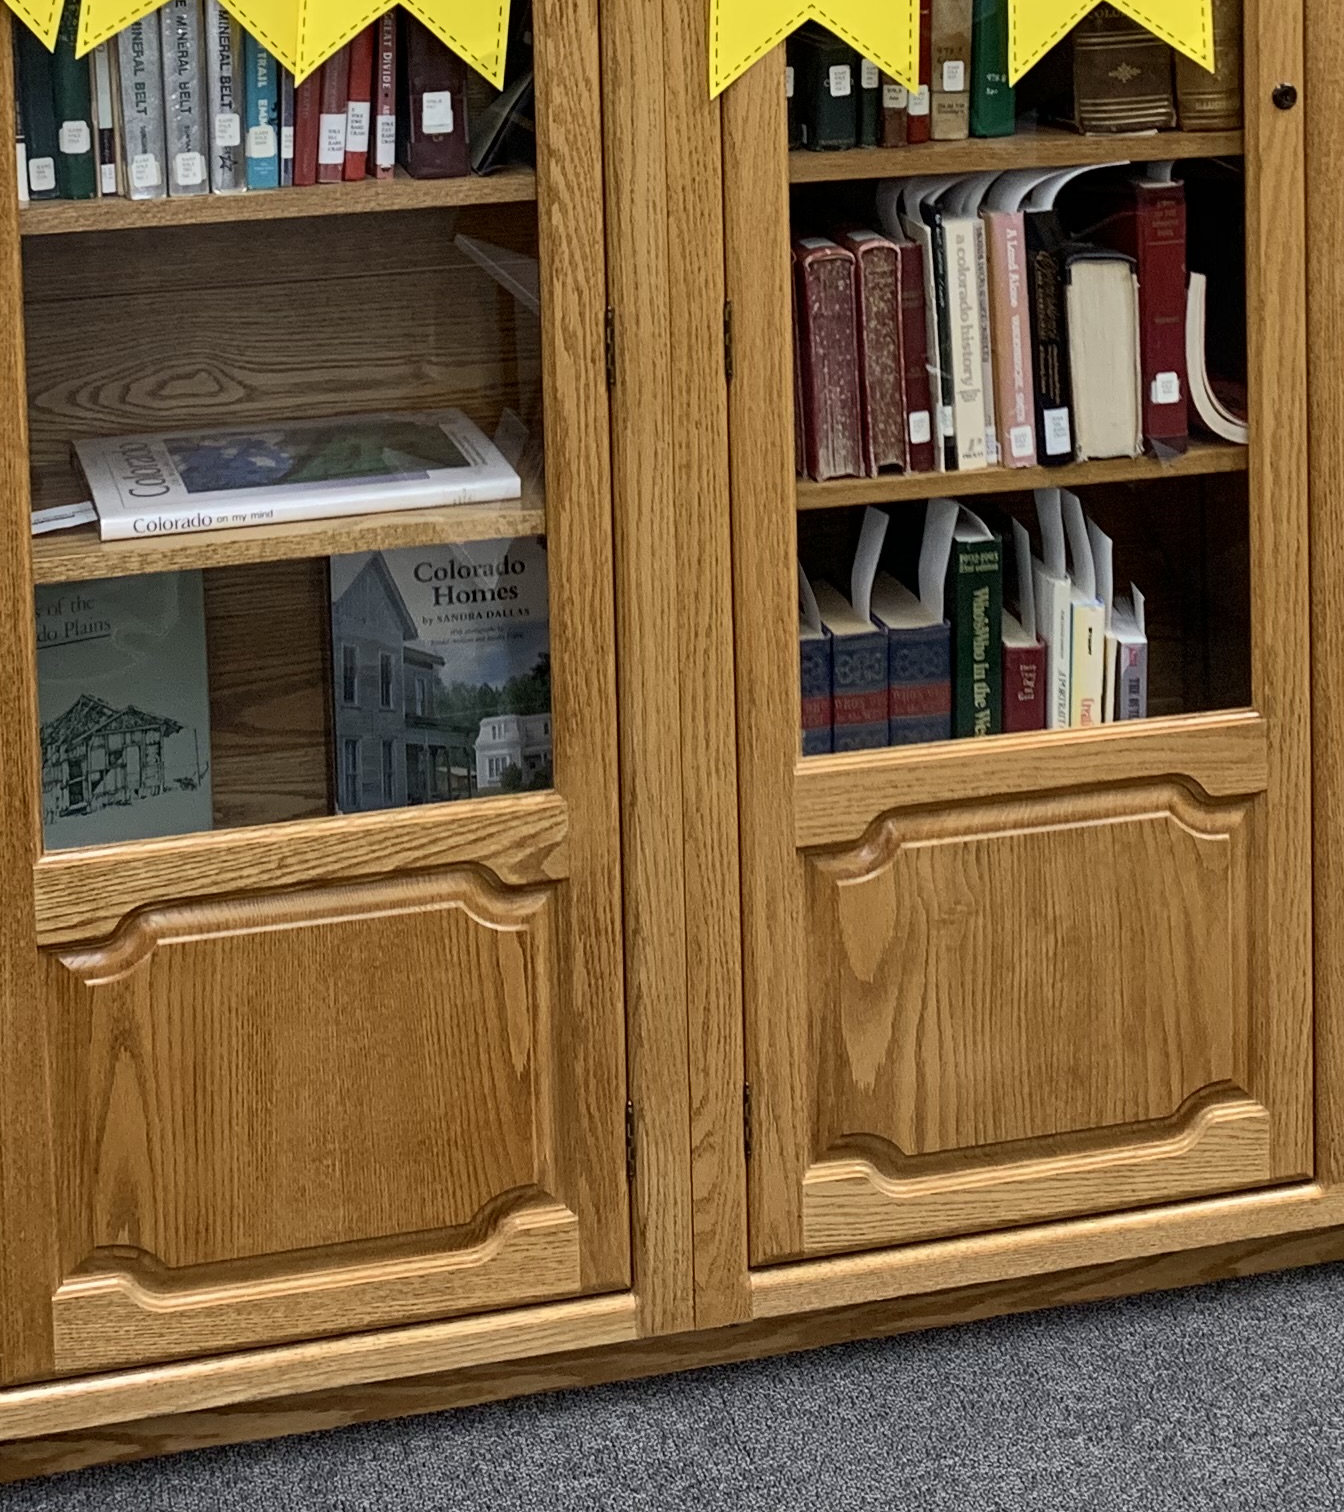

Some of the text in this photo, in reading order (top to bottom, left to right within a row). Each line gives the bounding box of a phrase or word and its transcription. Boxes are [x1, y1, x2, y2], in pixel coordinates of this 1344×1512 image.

[219, 9, 232, 72] MINERAL
[176, 15, 192, 114] MINERAL BELT
[135, 82, 148, 115] BELT
[957, 248, 972, 321] colorado
[959, 324, 974, 386] history
[128, 441, 170, 499] Colorado
[132, 512, 213, 535] Colorado
[232, 513, 248, 526] my
[414, 555, 526, 583] Colorado
[47, 596, 95, 617] of the
[433, 584, 519, 607] Homes
[64, 617, 111, 637] Plains
[436, 611, 483, 624] SANDRA
[486, 607, 531, 621] DALLAS
[973, 625, 989, 660] Who
[974, 663, 989, 679] in
[974, 683, 990, 708] the
[974, 708, 991, 737] We
